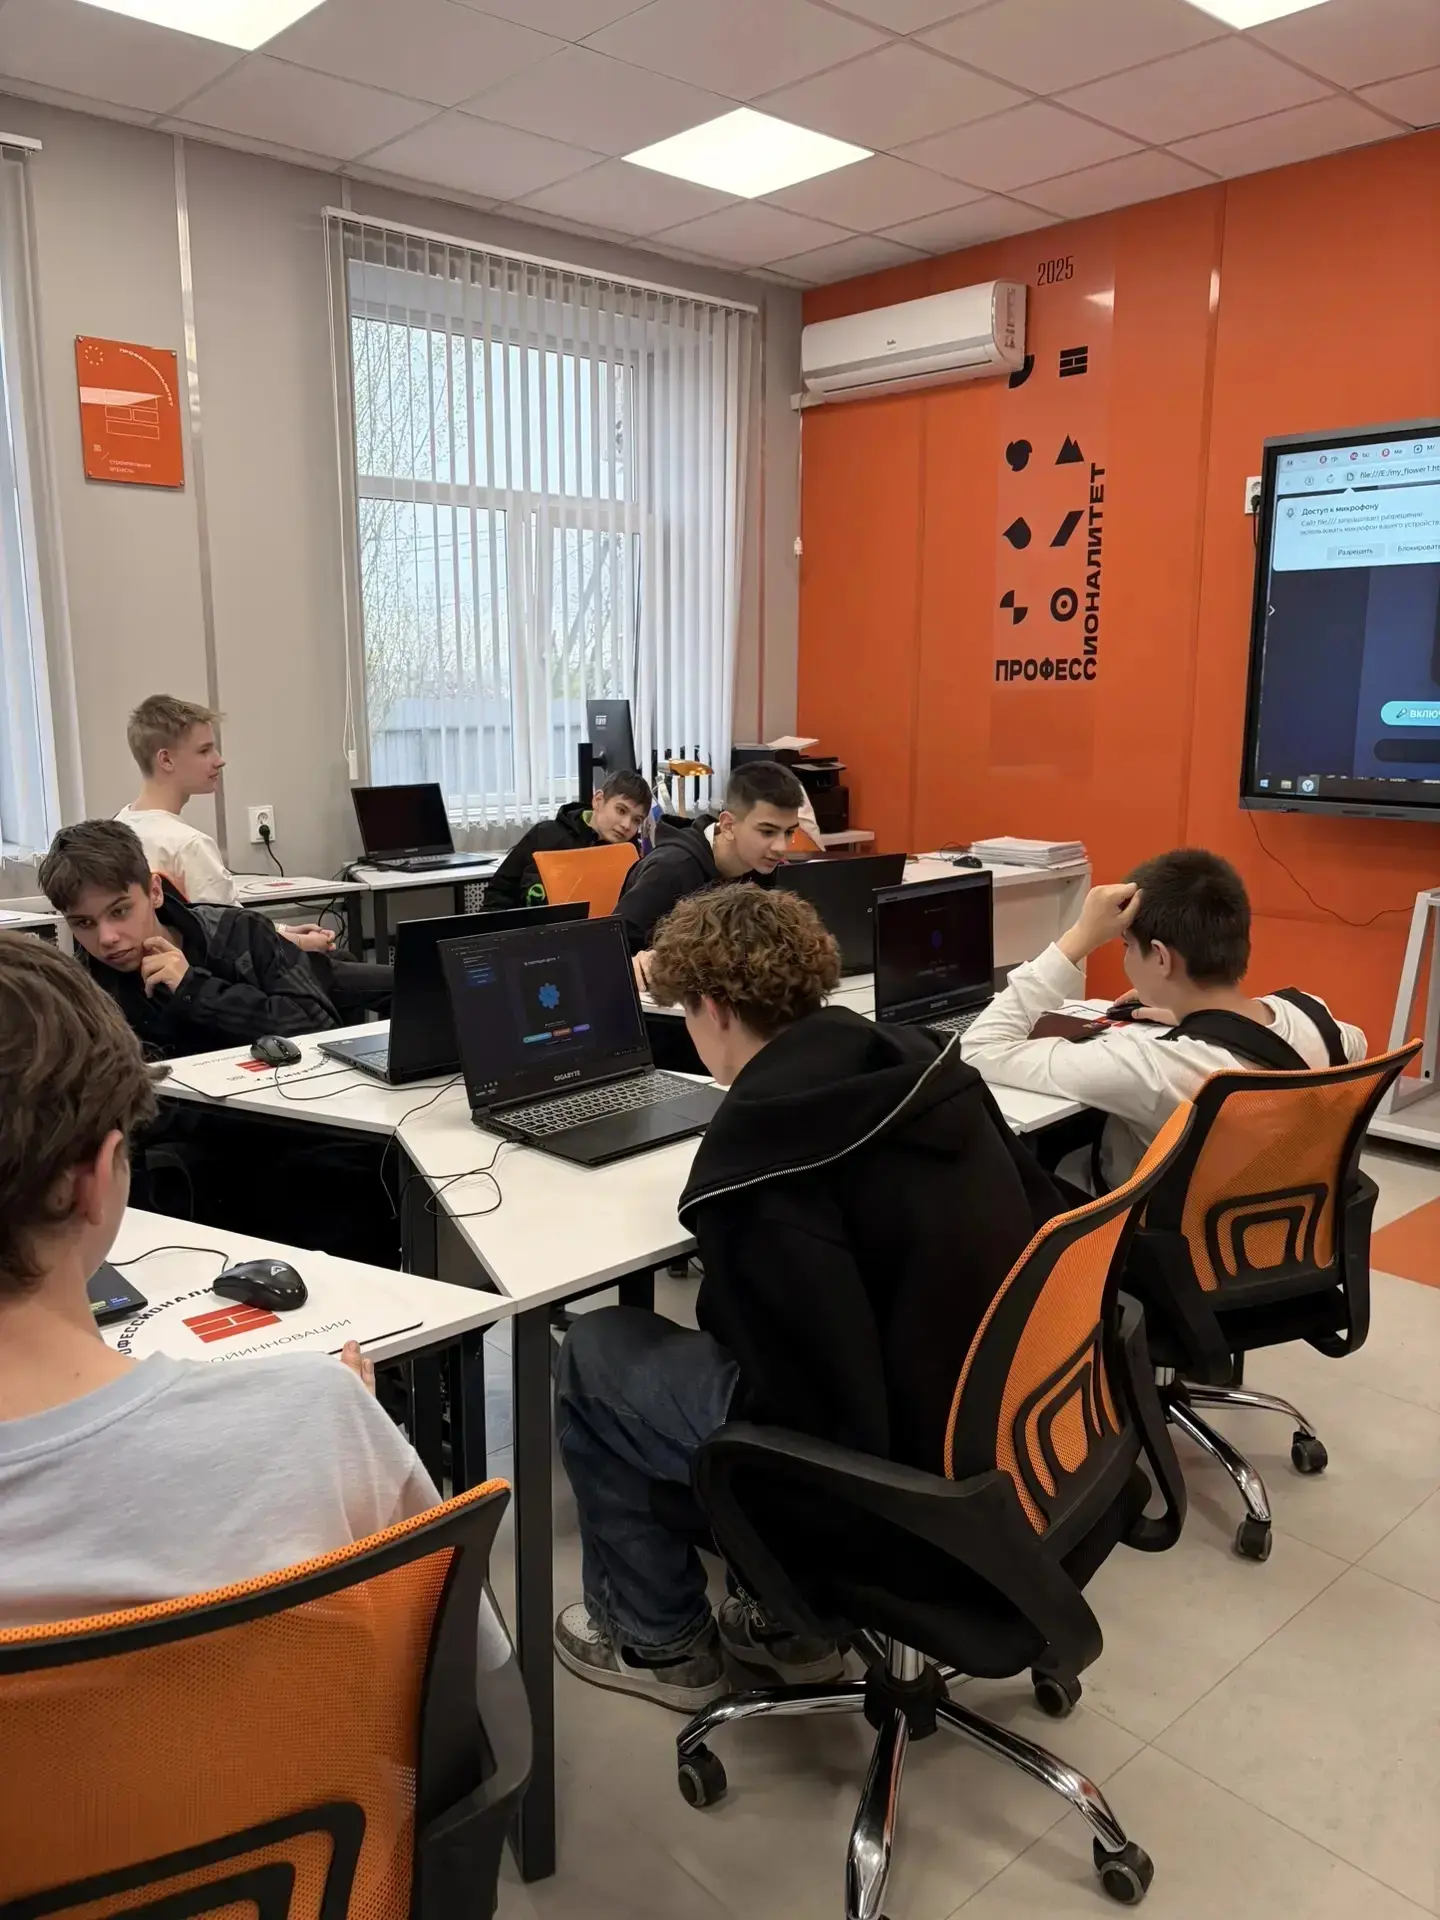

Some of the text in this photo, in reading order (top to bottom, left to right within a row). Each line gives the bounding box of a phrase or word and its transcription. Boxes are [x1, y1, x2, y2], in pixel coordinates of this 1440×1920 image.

[1037, 256, 1074, 286] 2025
[1301, 507, 1329, 516] Доступ
[1335, 503, 1380, 513] микрофону
[1404, 519, 1440, 528] устройств
[553, 1070, 581, 1081] GIGABYTE
[117, 1286, 214, 1355] ОФЕССИОНАЛИ
[206, 1318, 352, 1363] ОЙИННОВАЦИИ
